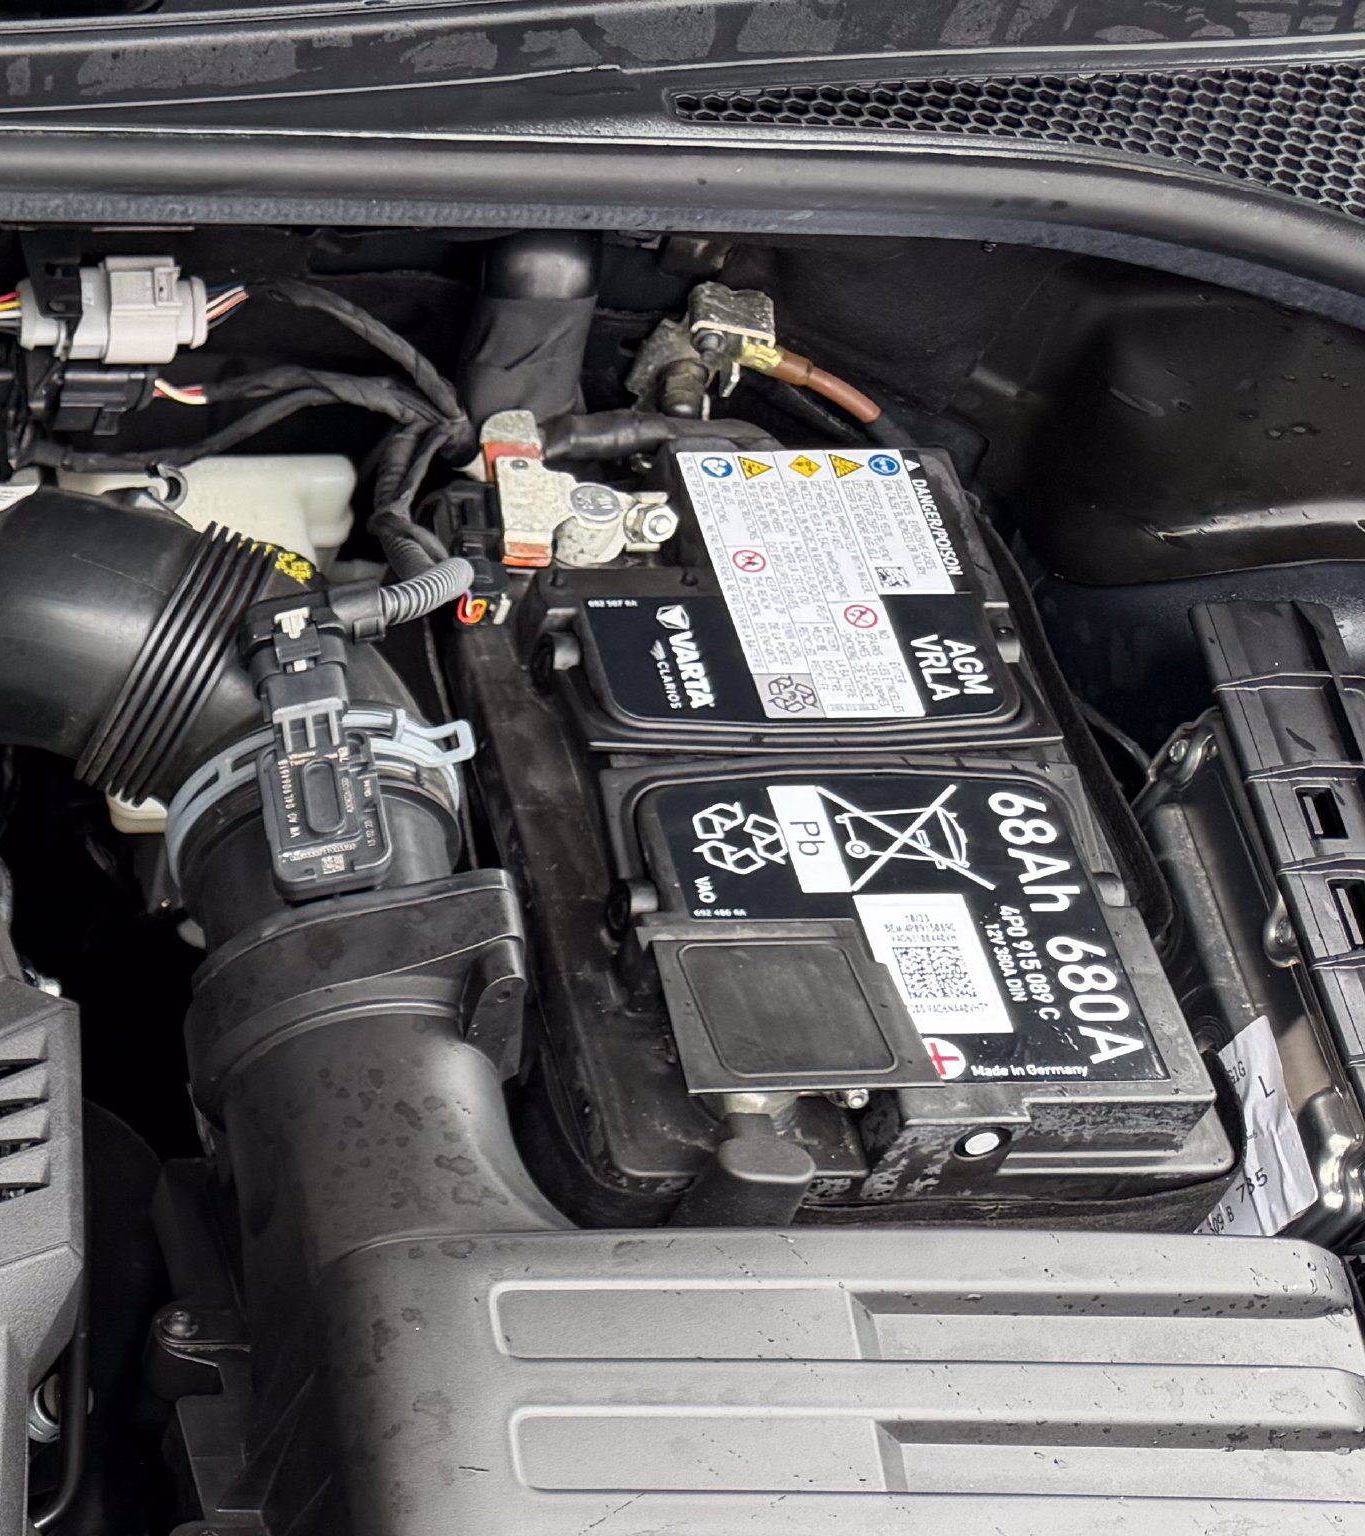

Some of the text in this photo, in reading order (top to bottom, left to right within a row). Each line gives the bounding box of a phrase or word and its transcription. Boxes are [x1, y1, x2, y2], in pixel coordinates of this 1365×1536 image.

[910, 478, 964, 577] DANGER/POISON
[656, 661, 682, 709] CLARIOS
[669, 630, 715, 709] VARTA
[911, 634, 961, 702] VRLA
[944, 639, 994, 696] AGM
[790, 820, 822, 857] Pb
[981, 922, 1007, 945] 12V
[1005, 979, 1028, 1001] DIN
[988, 792, 1144, 1065] 68Ah 680A
[999, 905, 1061, 1020] 4P0 915 089 C
[970, 1064, 1088, 1077] Made in Germany
[1258, 1075, 1276, 1098] L
